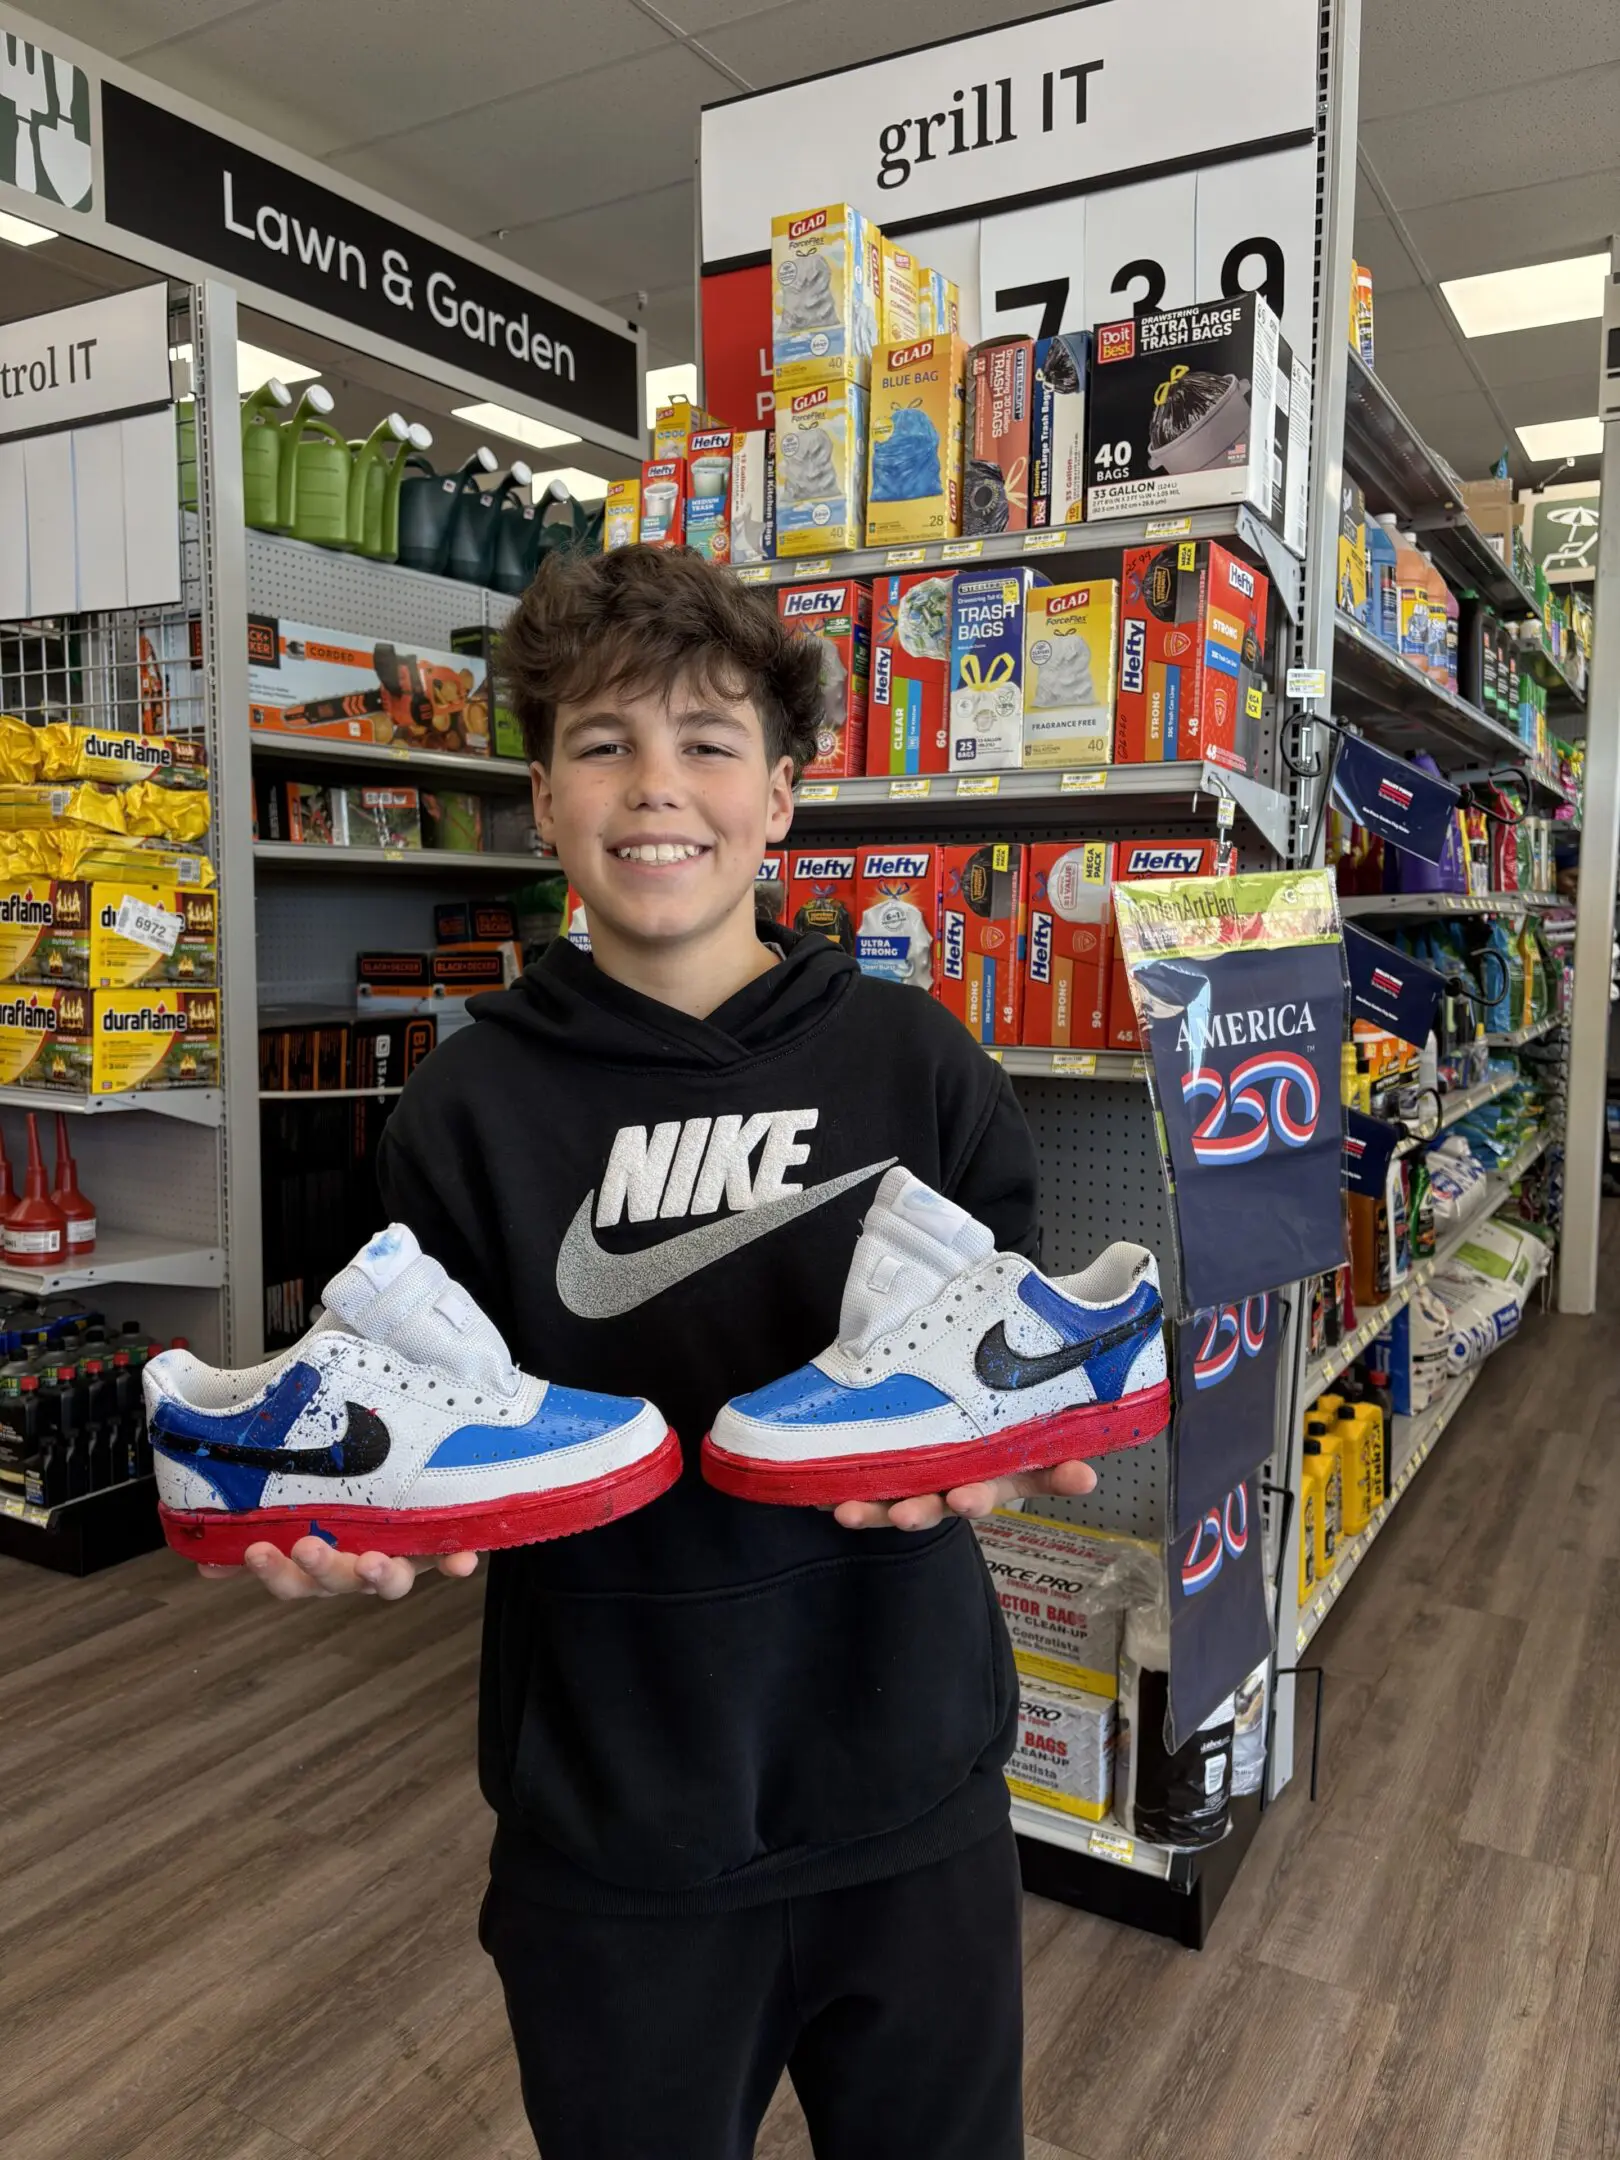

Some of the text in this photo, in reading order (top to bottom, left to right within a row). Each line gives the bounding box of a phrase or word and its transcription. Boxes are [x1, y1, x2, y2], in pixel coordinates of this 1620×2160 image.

[877, 60, 1105, 190] grill IT
[791, 211, 826, 238] GLAD
[222, 170, 577, 382] Lawn & Garden
[1221, 237, 1286, 323] 9
[1141, 307, 1200, 325] DRAWSTRING
[1141, 308, 1242, 338] EXTRA LARGE
[1102, 327, 1130, 345] Do it
[1140, 323, 1233, 351] TRASH BAGS
[69, 338, 97, 384] IT
[828, 357, 843, 368] 40
[891, 341, 932, 367] GLAD
[1103, 342, 1130, 359] Best
[882, 371, 939, 389] BLUE BAG
[1003, 349, 1013, 433] Drawstring 30 Gallon
[793, 390, 827, 411] GLAD
[992, 352, 1005, 438] TRASH BAGS
[1041, 416, 1049, 440] Trash
[694, 434, 729, 448] Hefty
[1040, 443, 1050, 468] Large
[1095, 441, 1132, 468] 40
[650, 465, 675, 476] Hefty
[767, 459, 775, 478] Tall
[1097, 468, 1130, 481] BAGS
[1039, 471, 1047, 496] Extra
[1093, 489, 1106, 500] 33
[1109, 481, 1155, 498] GALLON
[766, 480, 774, 519] Kitchen
[929, 515, 944, 527] 28
[764, 521, 773, 546] Bags
[1230, 567, 1254, 597] Hefty
[787, 591, 840, 614] Hefty
[958, 604, 1015, 623] TRASH
[1049, 592, 1088, 614] GLAD
[958, 621, 1004, 641] BAGS
[1046, 615, 1086, 626] ForceFlex
[1212, 618, 1238, 640] STRONG
[309, 646, 355, 662] CORDED
[1124, 623, 1144, 688] Hefty
[876, 651, 890, 701] Hefty
[1031, 718, 1097, 731] FRAGRANCE FREE
[1151, 691, 1161, 739] STRONG
[894, 707, 904, 750] CLEAR
[936, 730, 946, 748] 60
[1188, 718, 1199, 737] 48
[85, 735, 172, 767] duraflame
[959, 741, 973, 751] 25
[1087, 738, 1104, 751] 40
[1206, 743, 1217, 761] 48
[797, 859, 852, 877] Hefty
[866, 856, 925, 875] Hefty
[1086, 848, 1094, 878] MEGA
[1094, 852, 1102, 878] PACK
[1131, 851, 1197, 872] Hefty
[135, 915, 167, 939] 6972
[569, 935, 591, 943] ULTR
[861, 939, 891, 948] ULTRA
[861, 948, 898, 957] STRONG
[945, 914, 964, 975] Hefty
[1033, 916, 1052, 979] Hefty
[970, 980, 979, 1024] STRONG
[1057, 979, 1067, 1027] STRONG
[103, 1008, 188, 1032] duraflame
[1003, 1006, 1014, 1024] 48
[1092, 1010, 1102, 1028] 90
[1175, 1002, 1316, 1051] AMERICA
[1181, 1050, 1321, 1166] 250
[596, 1108, 819, 1228] NIKE
[985, 1560, 1084, 1594] ORCE PRO
[996, 1591, 1088, 1630] ACTOR BAGS
[1025, 1614, 1089, 1640] CLEAN-UP
[1013, 1626, 1080, 1653] Contratista
[1019, 1701, 1062, 1721] PRO
[1024, 1730, 1068, 1757] BAGS
[1008, 1757, 1057, 1780] tratista
[1014, 1746, 1070, 1767] EAN-UP
